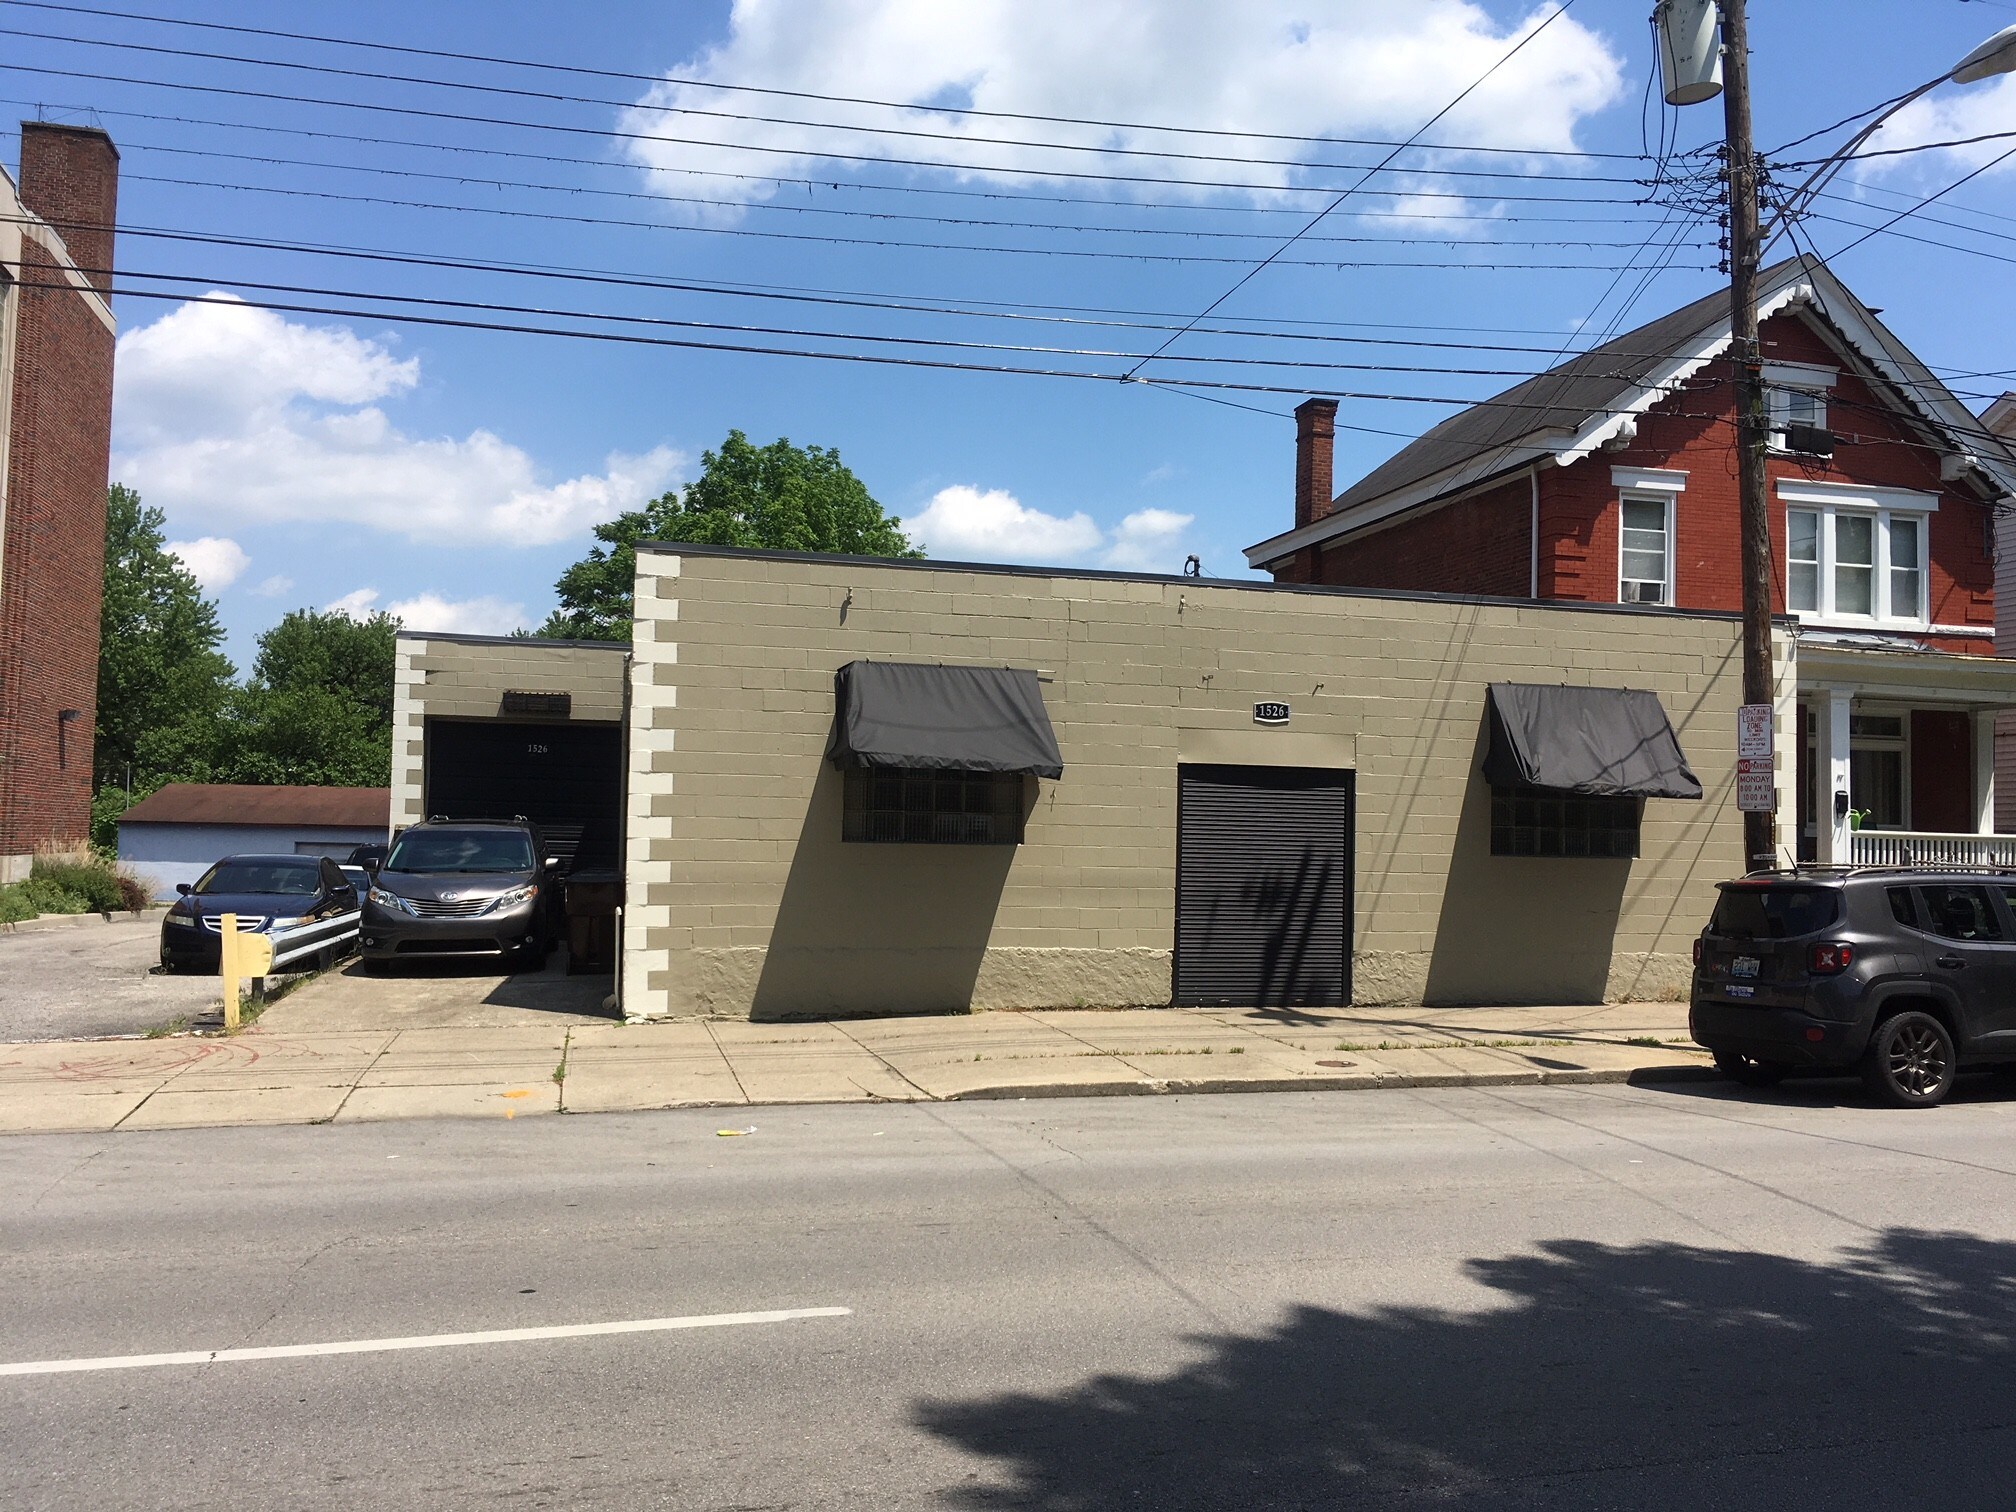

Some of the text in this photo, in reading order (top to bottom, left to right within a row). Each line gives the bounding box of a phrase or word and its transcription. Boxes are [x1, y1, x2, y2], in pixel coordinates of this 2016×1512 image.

[1260, 705, 1285, 717] 1526
[1747, 722, 1763, 730] ZONE
[528, 744, 548, 753] 1526
[1739, 762, 1772, 771] NO PARKING
[1740, 775, 1770, 783] MONDAY
[1760, 793, 1768, 801] AM
